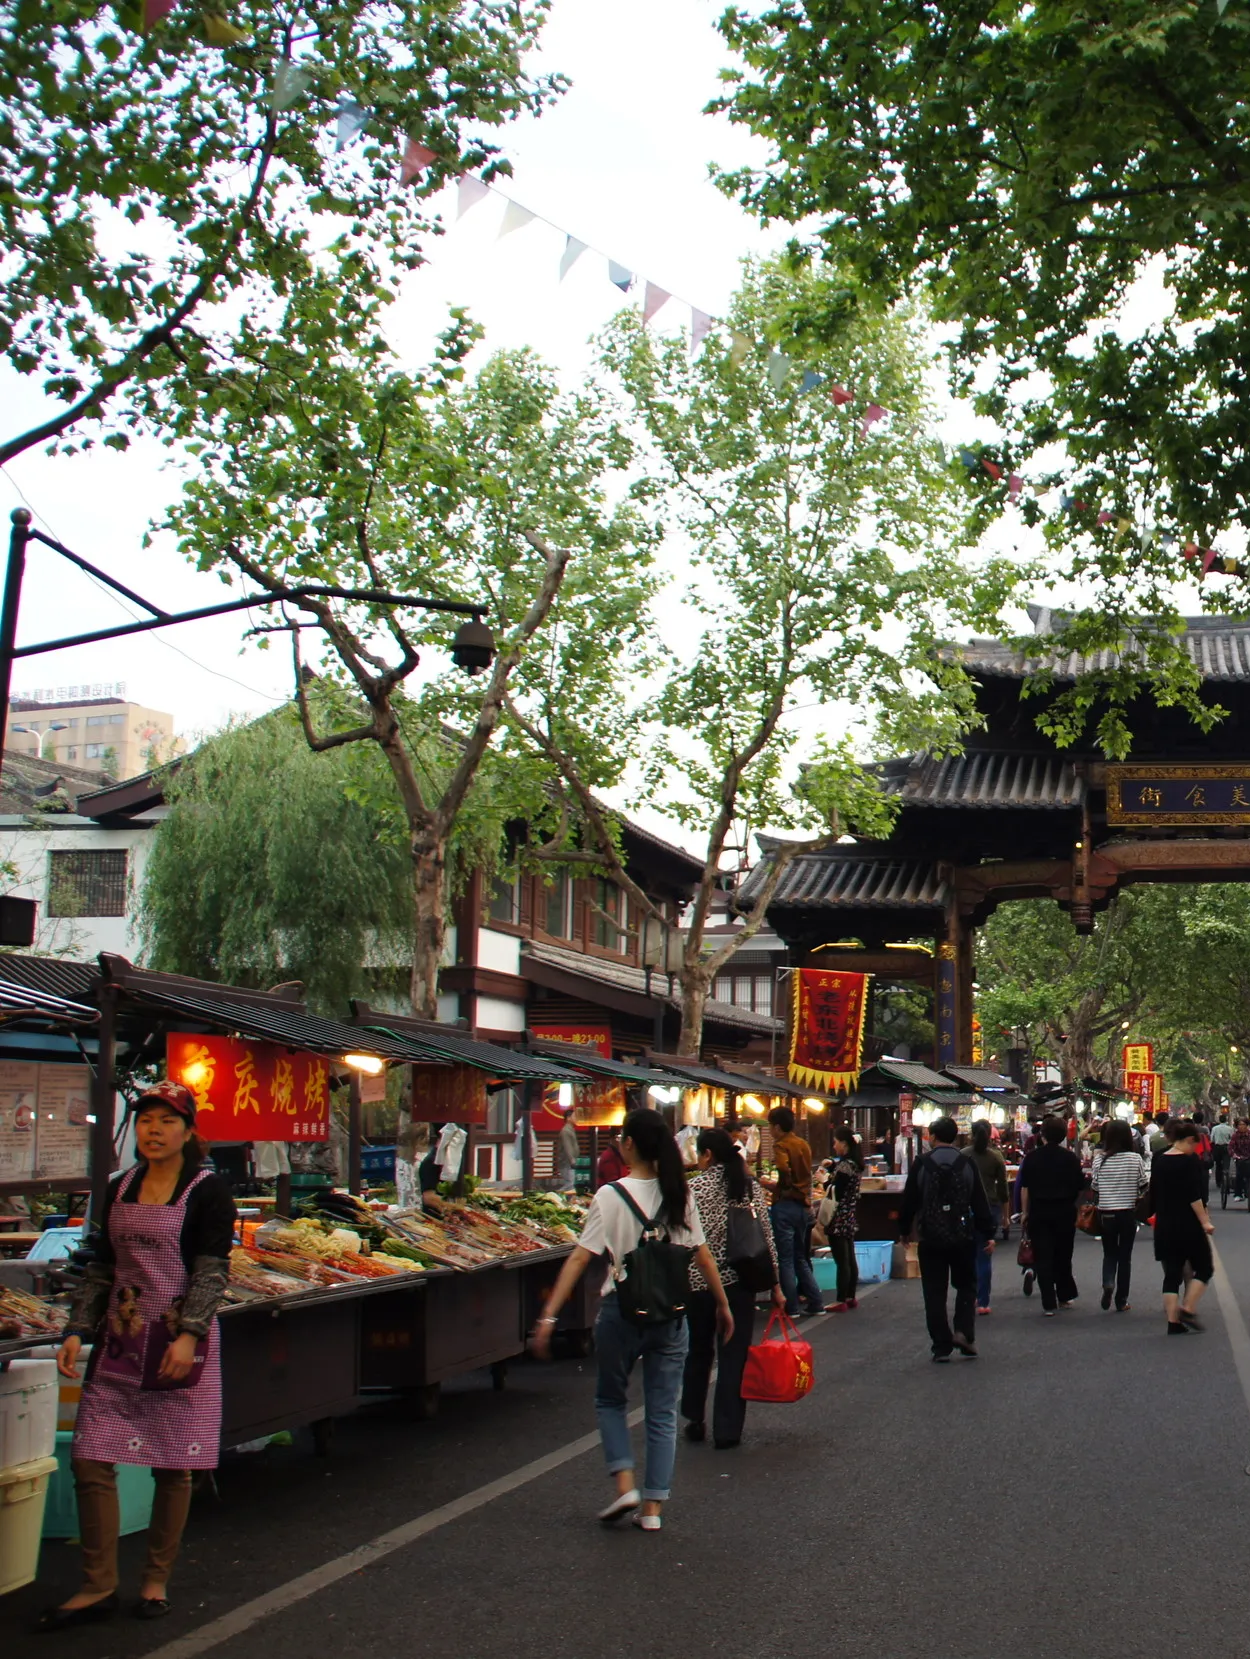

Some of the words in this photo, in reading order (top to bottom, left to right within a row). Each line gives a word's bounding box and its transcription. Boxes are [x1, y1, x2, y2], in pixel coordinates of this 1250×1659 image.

[181, 1045, 328, 1121] 重庆烧烤
[292, 1122, 326, 1136] 麻辣鲜香
